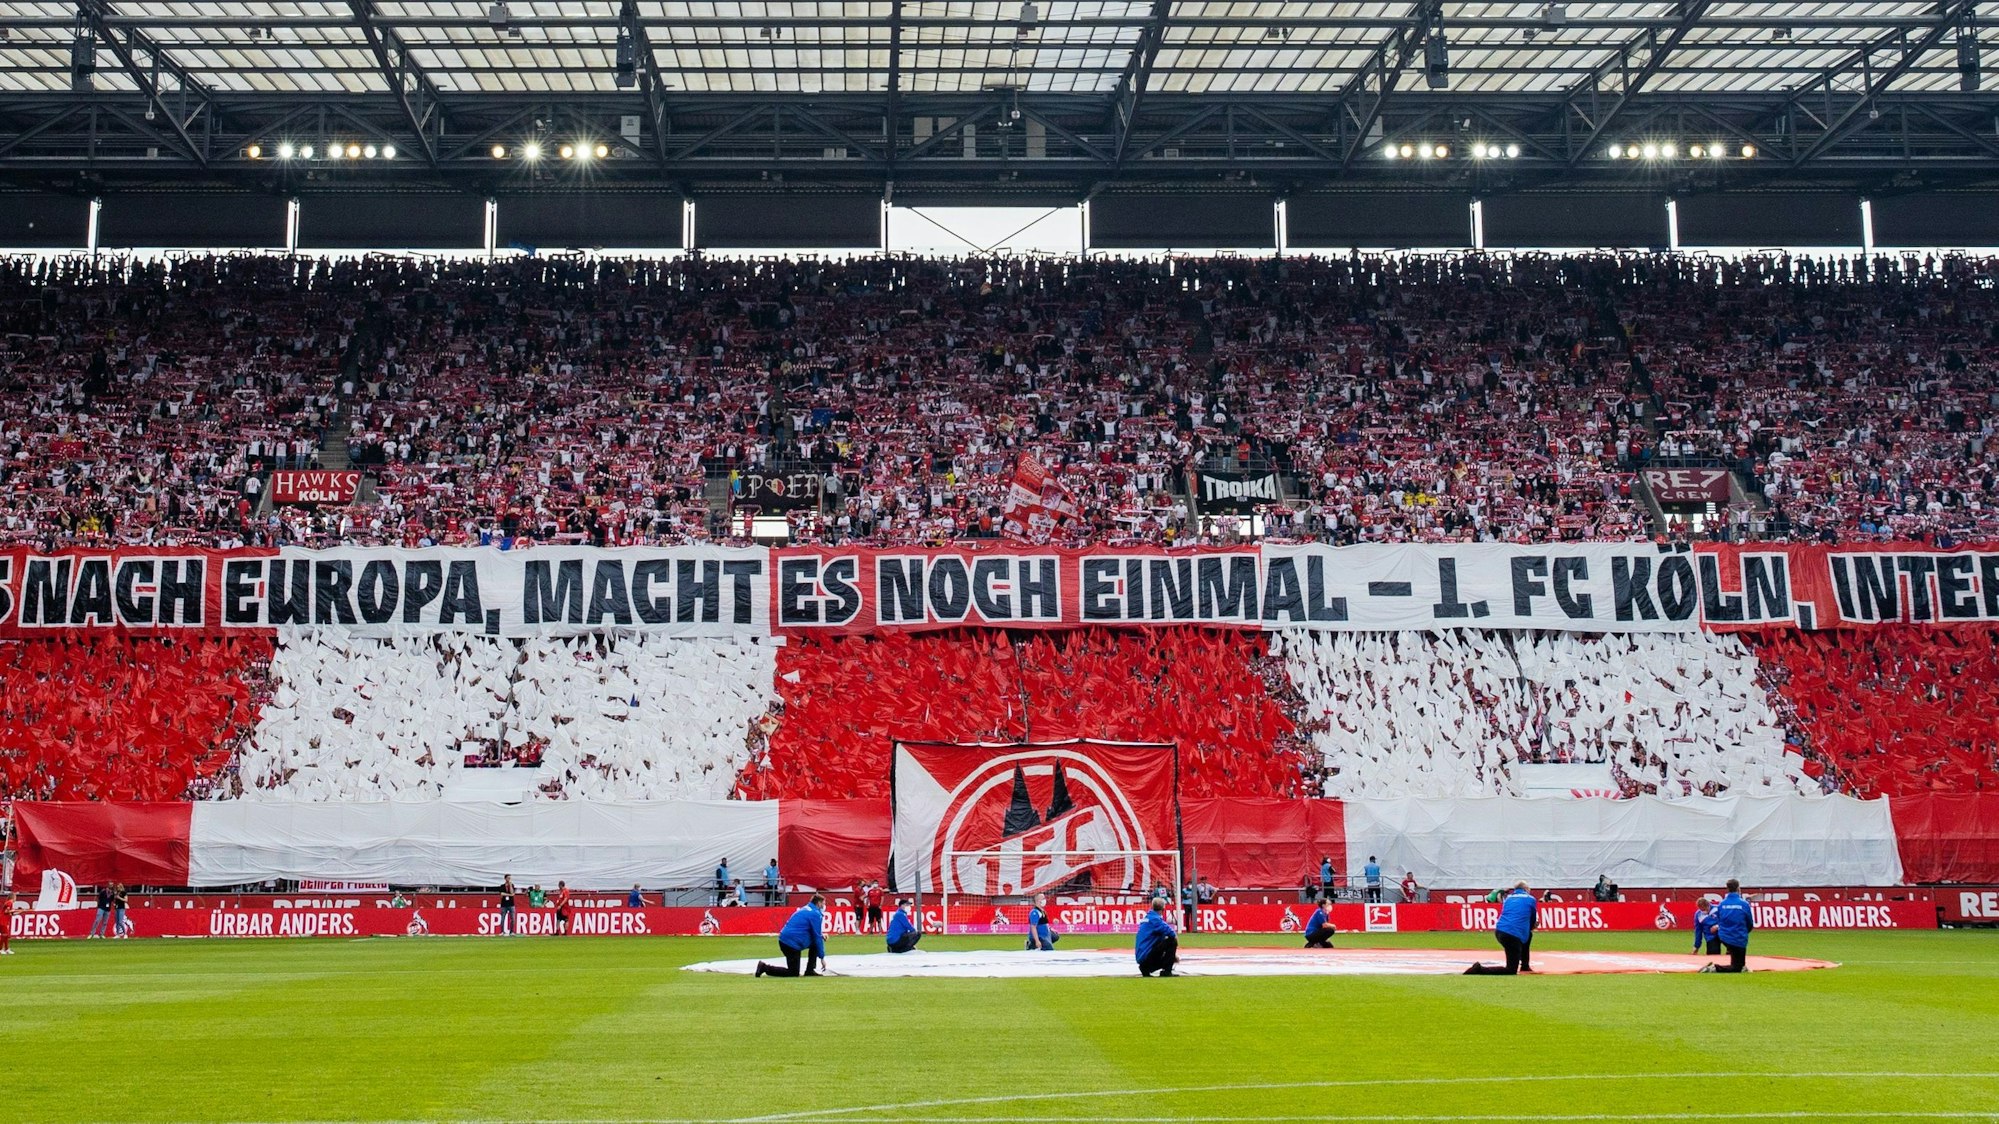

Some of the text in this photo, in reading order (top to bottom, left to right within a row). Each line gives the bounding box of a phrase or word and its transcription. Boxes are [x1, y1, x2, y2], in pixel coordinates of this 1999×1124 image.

[276, 473, 359, 495] HAWKS
[298, 488, 339, 501] KÖLN
[1202, 473, 1277, 501] TROIKA
[1661, 491, 1712, 499] CREW
[20, 557, 203, 626] NACH
[223, 557, 501, 636] EUROPA,
[522, 557, 762, 625] MACHT
[779, 557, 862, 625] ES
[877, 556, 1058, 622] NOCH
[1433, 556, 1490, 619] 1.
[1510, 555, 1594, 619] FC
[1611, 543, 1815, 631] KÖLN,
[210, 910, 359, 935] ÜRBAR ANDERS.
[571, 912, 651, 934] ANDERS.
[1751, 902, 1897, 928] ÜRBAR ANDERS.
